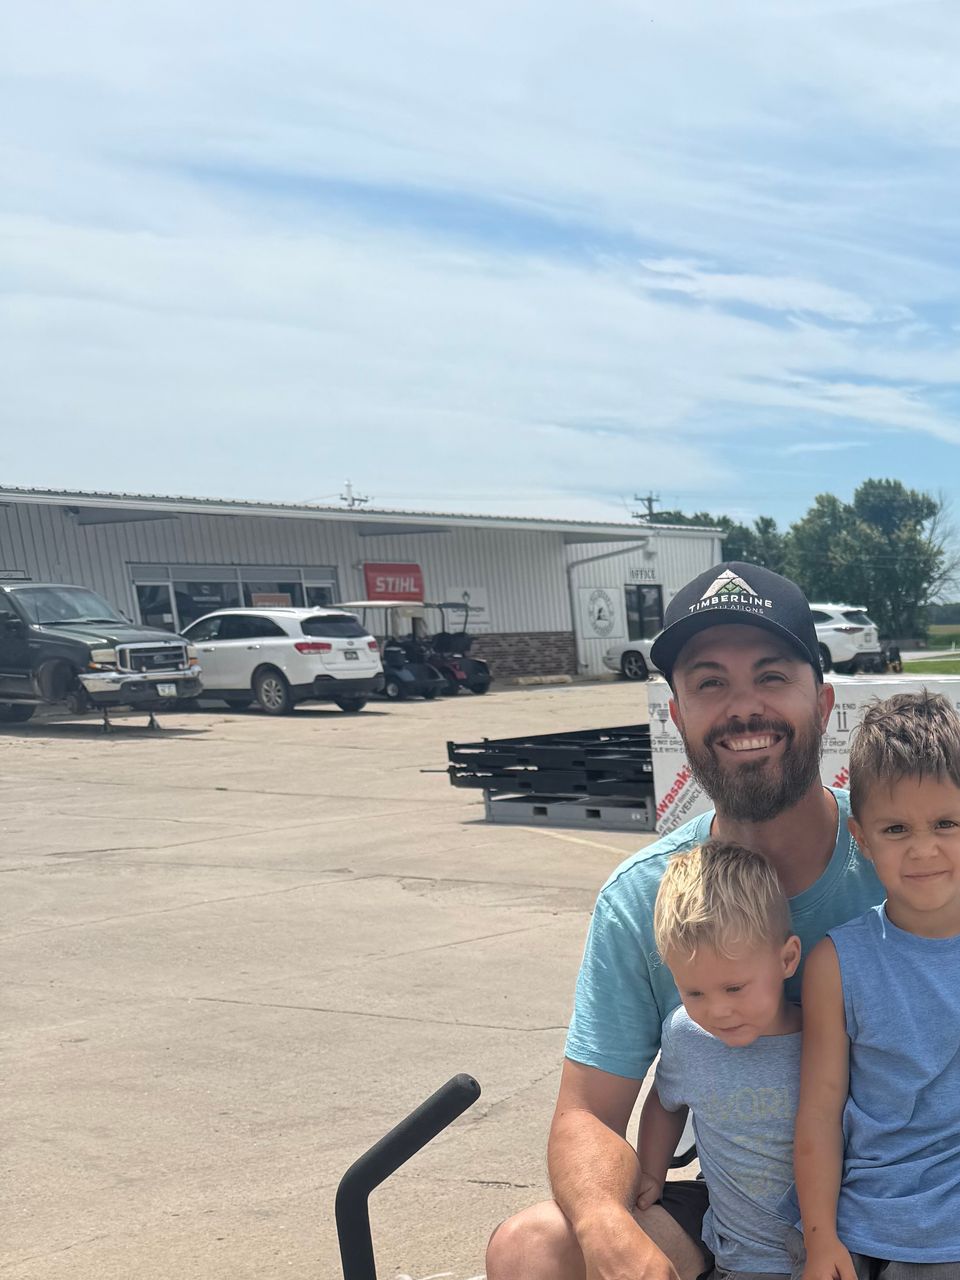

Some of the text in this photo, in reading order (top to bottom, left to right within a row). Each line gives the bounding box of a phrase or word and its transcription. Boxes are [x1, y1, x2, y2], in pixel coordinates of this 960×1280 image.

[375, 577, 419, 593] STIHL
[688, 594, 773, 613] TIMBERLINE
[679, 787, 702, 815] VEHICL
